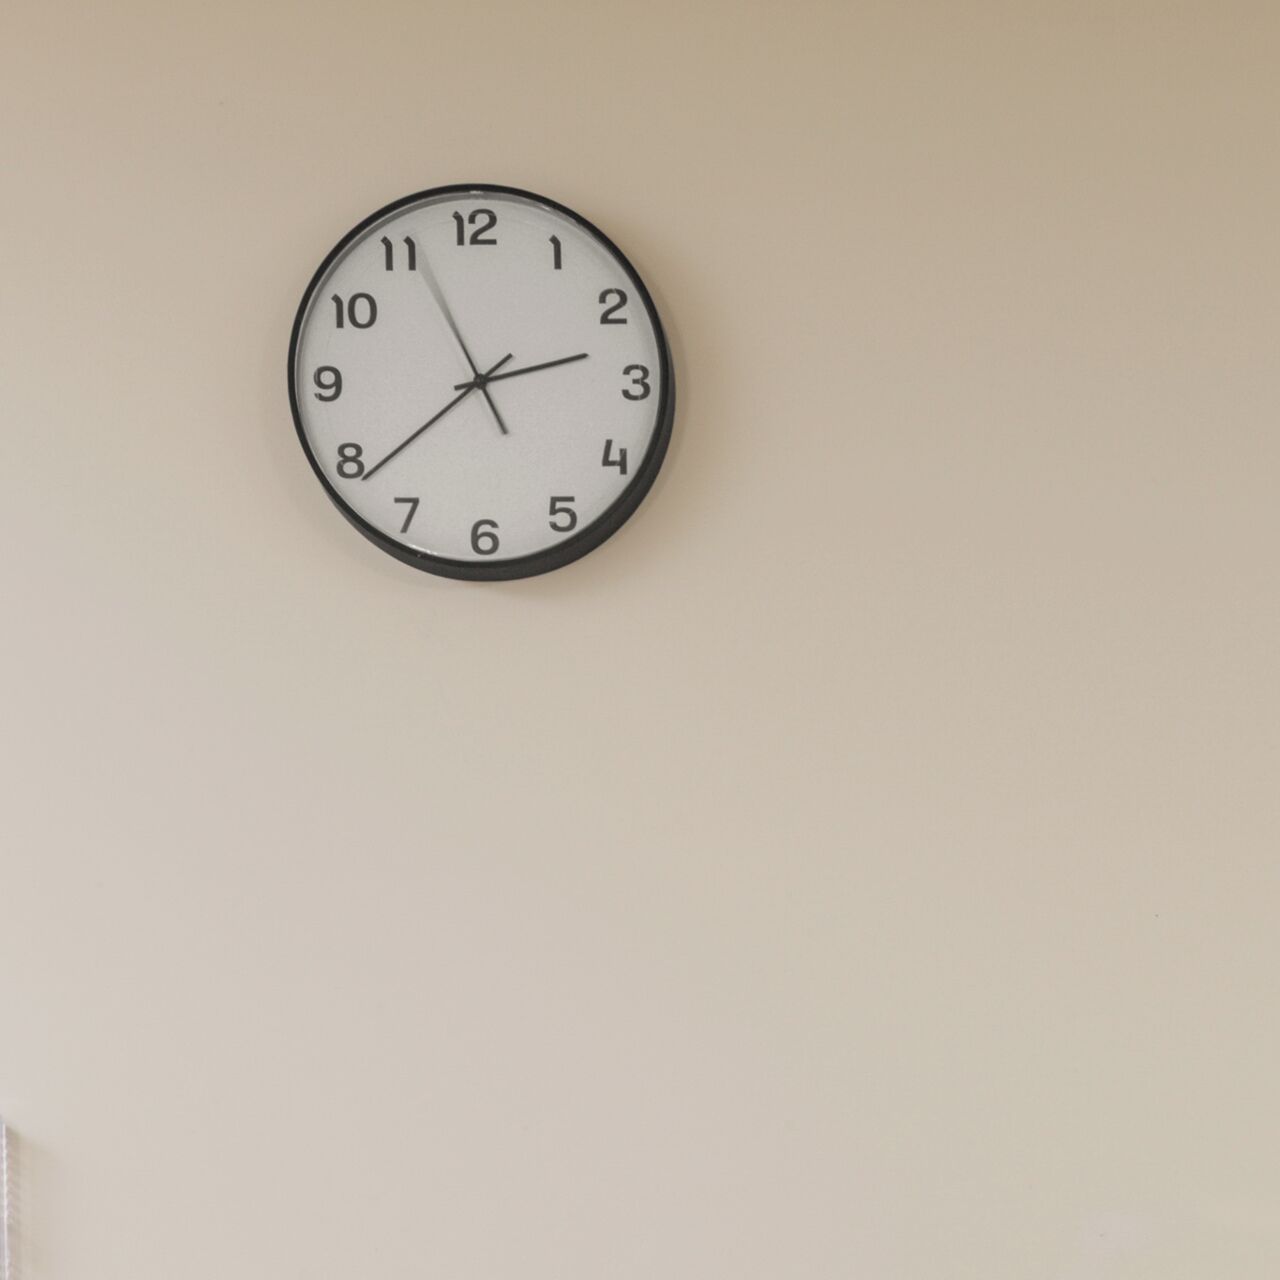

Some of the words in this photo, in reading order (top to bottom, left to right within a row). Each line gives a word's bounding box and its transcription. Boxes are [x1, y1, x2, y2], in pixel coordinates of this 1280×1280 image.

[453, 209, 497, 246] 12
[381, 236, 416, 271] 11
[549, 235, 561, 269] 1
[331, 293, 377, 329] 10
[599, 288, 627, 324] 2
[314, 366, 342, 402] 9
[622, 364, 651, 401] 3
[335, 442, 366, 480] 8
[602, 439, 627, 475] 4
[394, 498, 419, 533] 7
[548, 496, 578, 532] 5
[471, 519, 499, 555] 6
